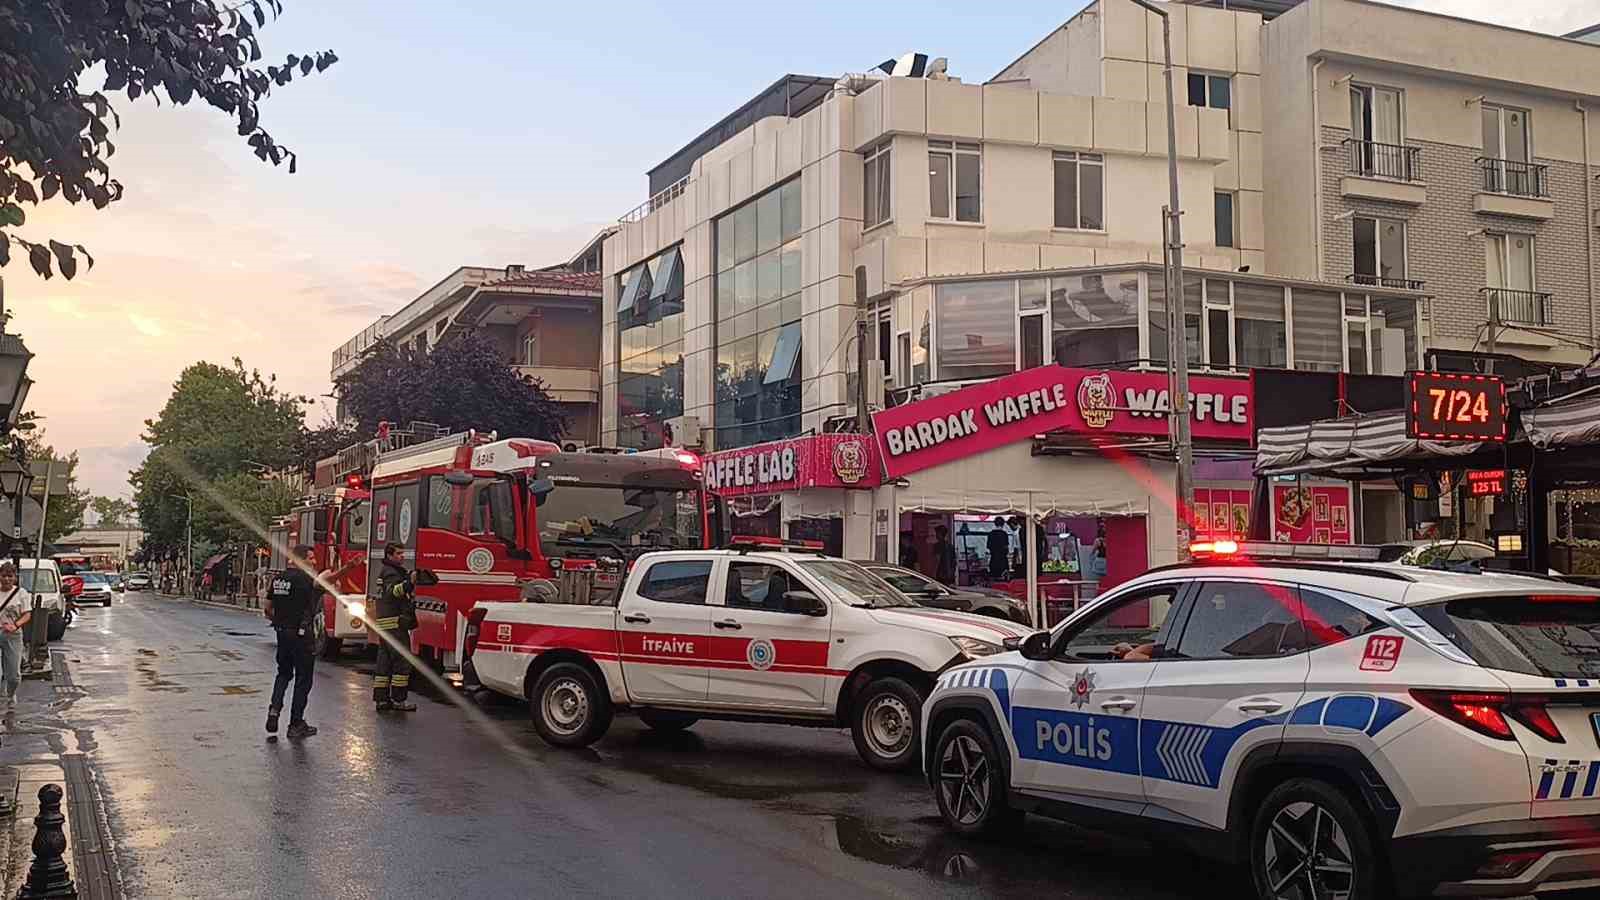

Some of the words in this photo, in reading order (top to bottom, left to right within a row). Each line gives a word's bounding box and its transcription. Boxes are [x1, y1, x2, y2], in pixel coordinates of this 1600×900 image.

[886, 408, 979, 456] BARDAK
[984, 384, 1067, 427] WAFFLE
[1125, 388, 1249, 423] WAFLE
[1429, 388, 1489, 422] 7/24
[704, 454, 754, 489] AFFLE
[758, 447, 795, 483] LAB
[1473, 482, 1489, 493] 125
[1491, 481, 1503, 492] TL
[642, 636, 695, 654] İTFAİYE
[1370, 639, 1397, 657] 112
[1036, 717, 1112, 760] POLİS
